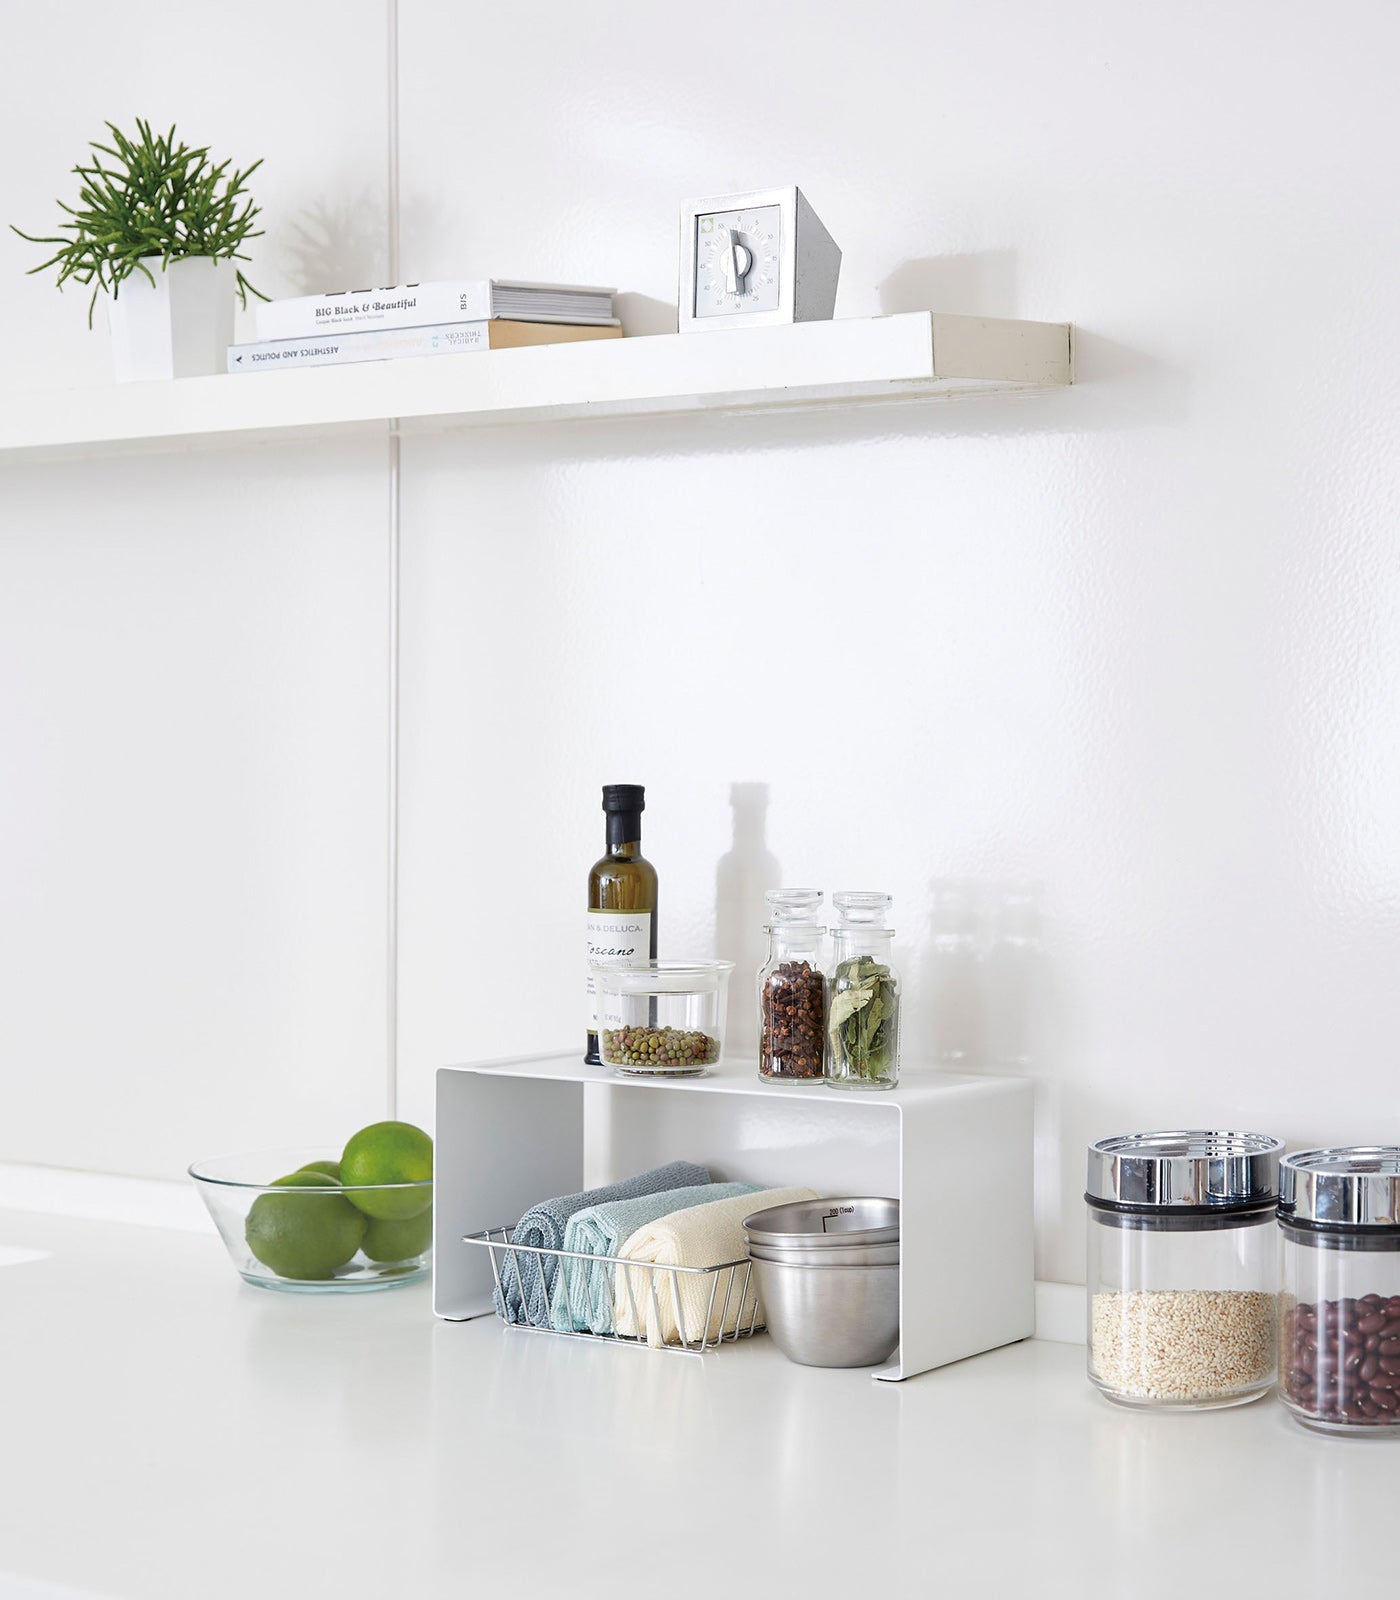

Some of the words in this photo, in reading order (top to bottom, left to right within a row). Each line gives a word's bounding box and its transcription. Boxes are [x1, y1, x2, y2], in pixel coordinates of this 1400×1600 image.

[315, 307, 332, 317] BIG
[335, 305, 360, 315] Black
[362, 303, 370, 312] &
[372, 298, 417, 311] Beautiful
[252, 352, 281, 362] POLITICS
[282, 350, 298, 359] AND
[300, 346, 339, 358] AESTHETICS
